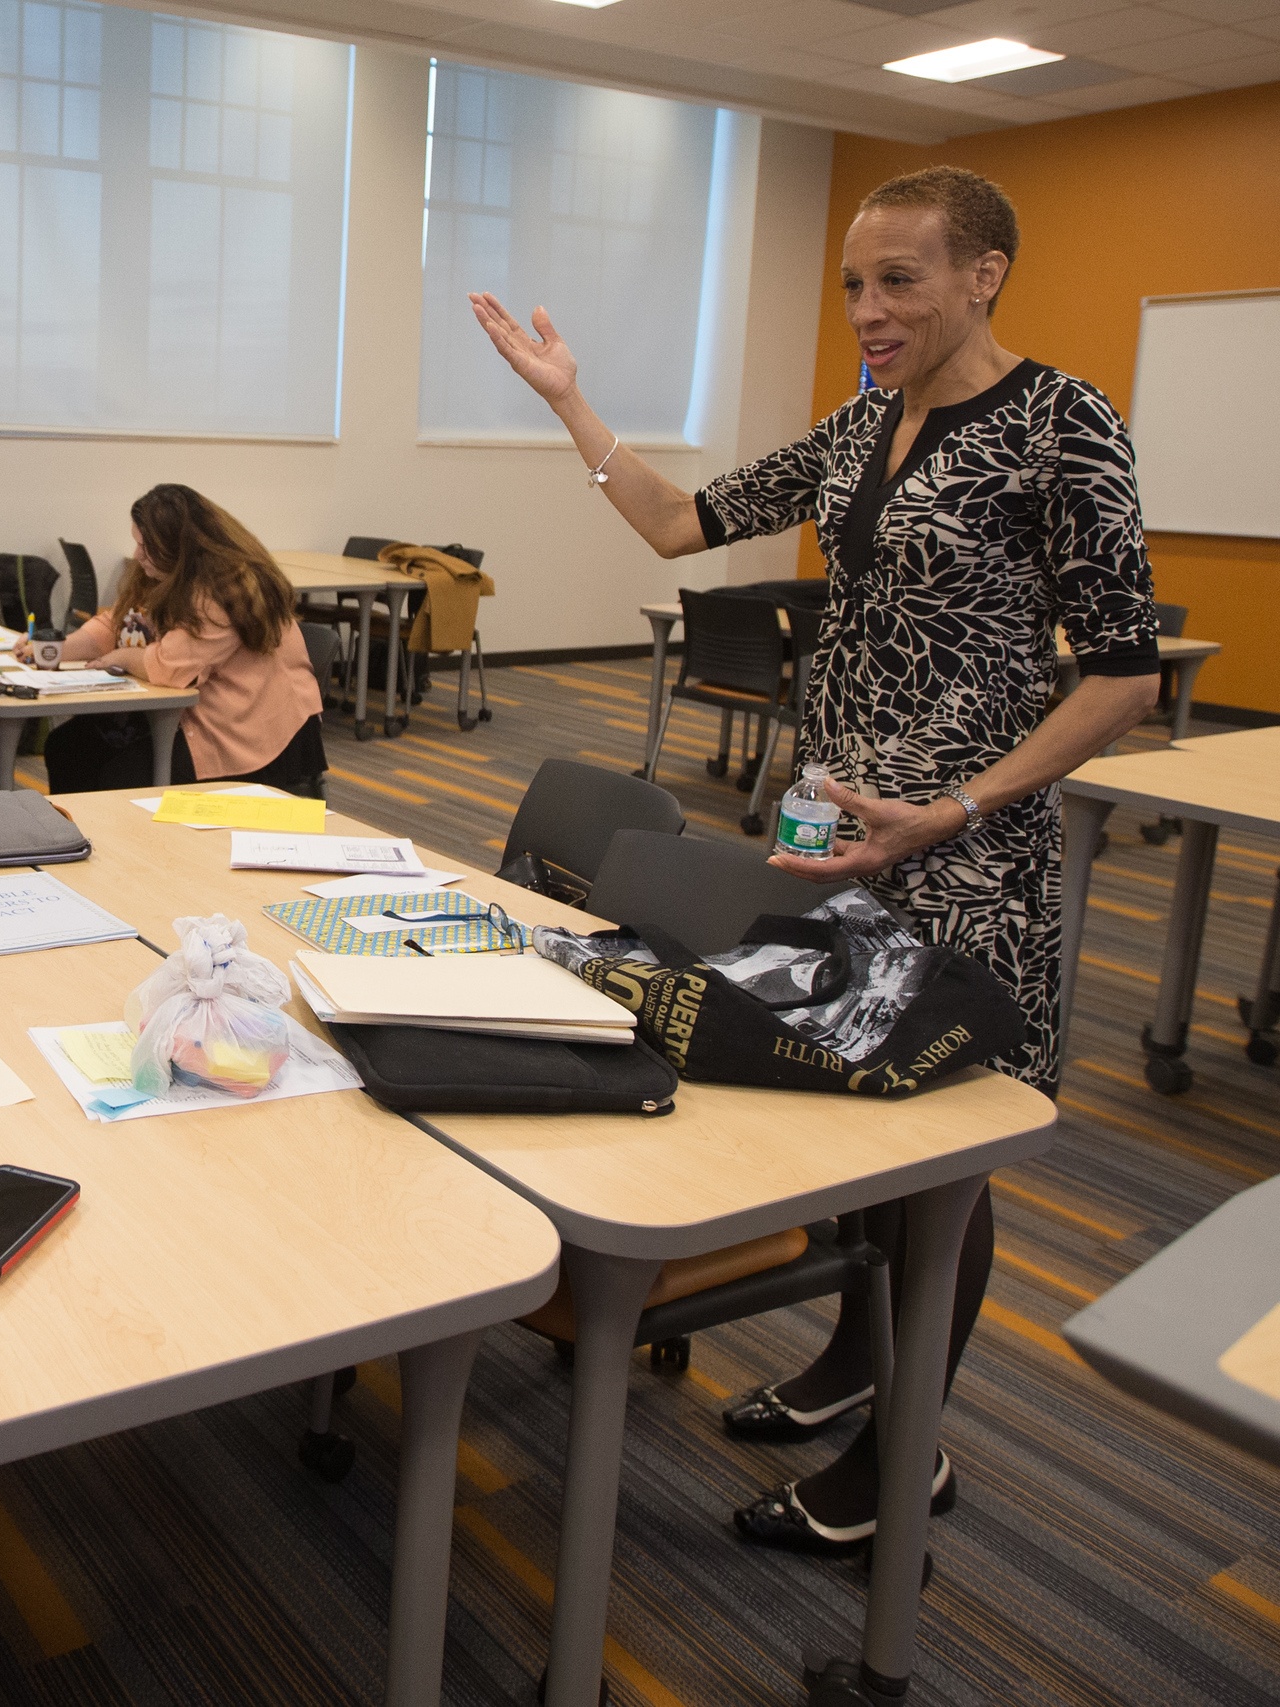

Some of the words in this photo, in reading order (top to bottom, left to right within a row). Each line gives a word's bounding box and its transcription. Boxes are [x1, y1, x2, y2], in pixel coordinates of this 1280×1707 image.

[0, 906, 36, 917] ACT
[31, 895, 61, 904] TO
[643, 981, 660, 1025] PUERTO
[654, 1001, 668, 1034] ERTO
[661, 977, 676, 1004] RICO
[664, 972, 708, 1069] PUERTO
[772, 1036, 844, 1074] RUTH
[909, 1024, 974, 1076] ROBIN
